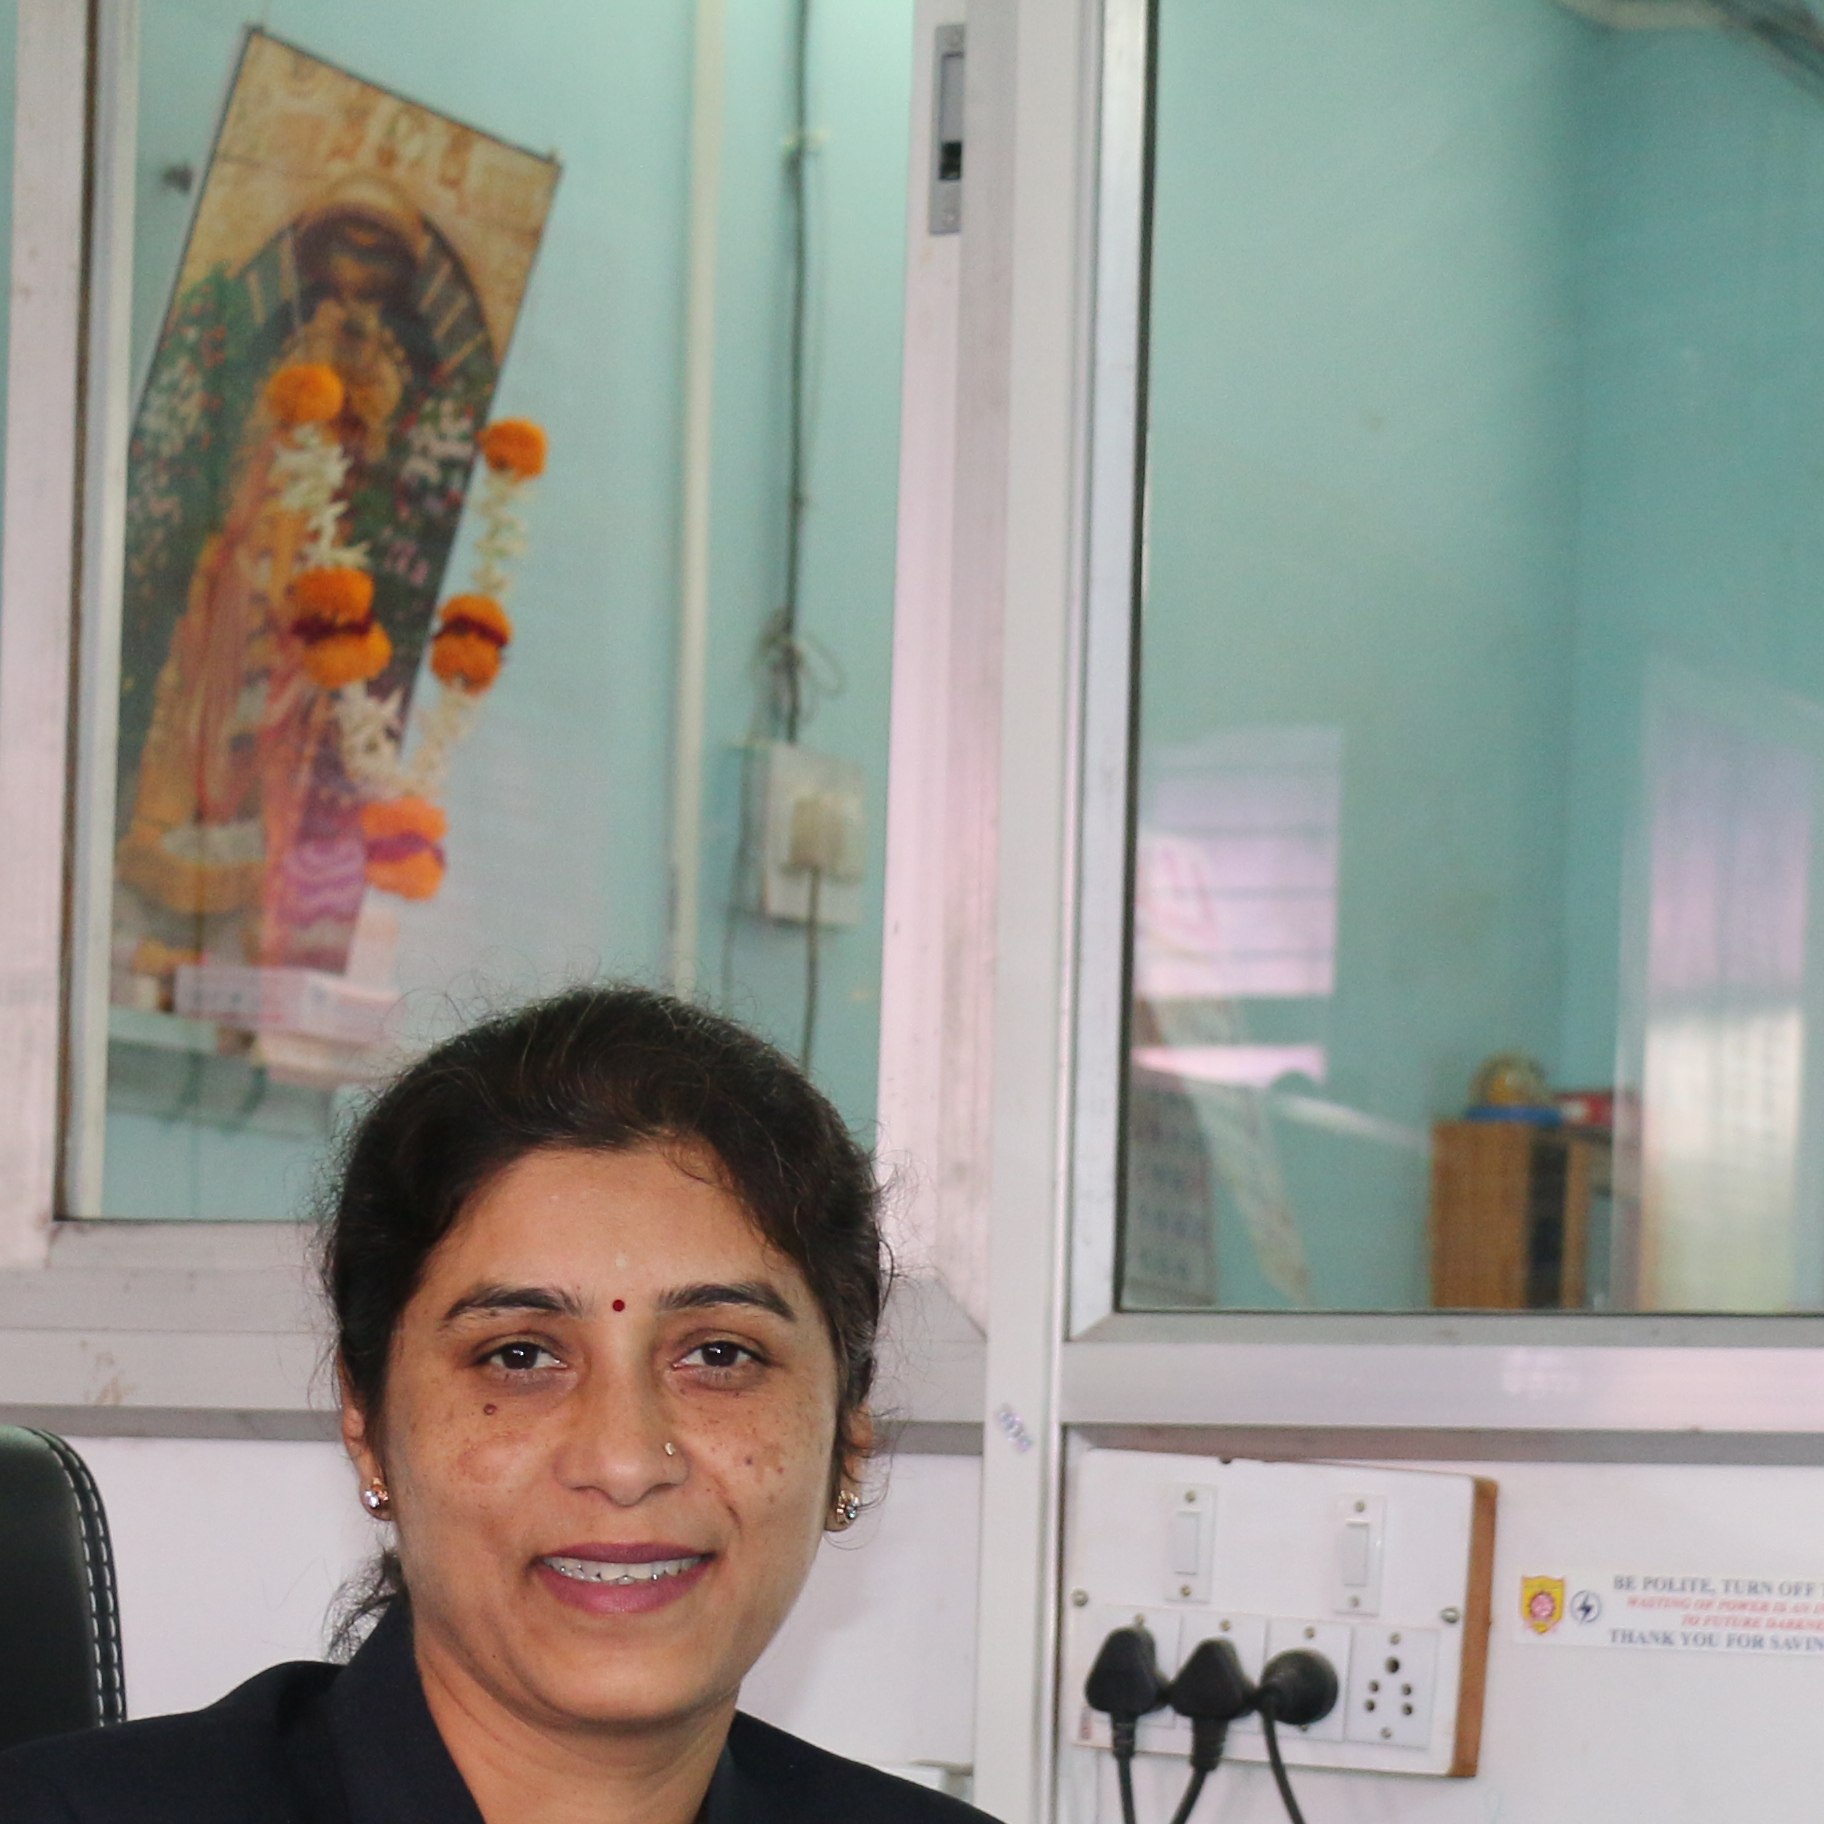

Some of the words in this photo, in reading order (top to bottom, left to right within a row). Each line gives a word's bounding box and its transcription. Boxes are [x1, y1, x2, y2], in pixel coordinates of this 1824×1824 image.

[1613, 1575, 1637, 1591] BE
[1721, 1579, 1775, 1595] TURN
[1779, 1580, 1816, 1597] OFF
[1608, 1627, 1675, 1646] THANK
[1680, 1631, 1720, 1648] YOU
[1726, 1633, 1765, 1649] FOR
